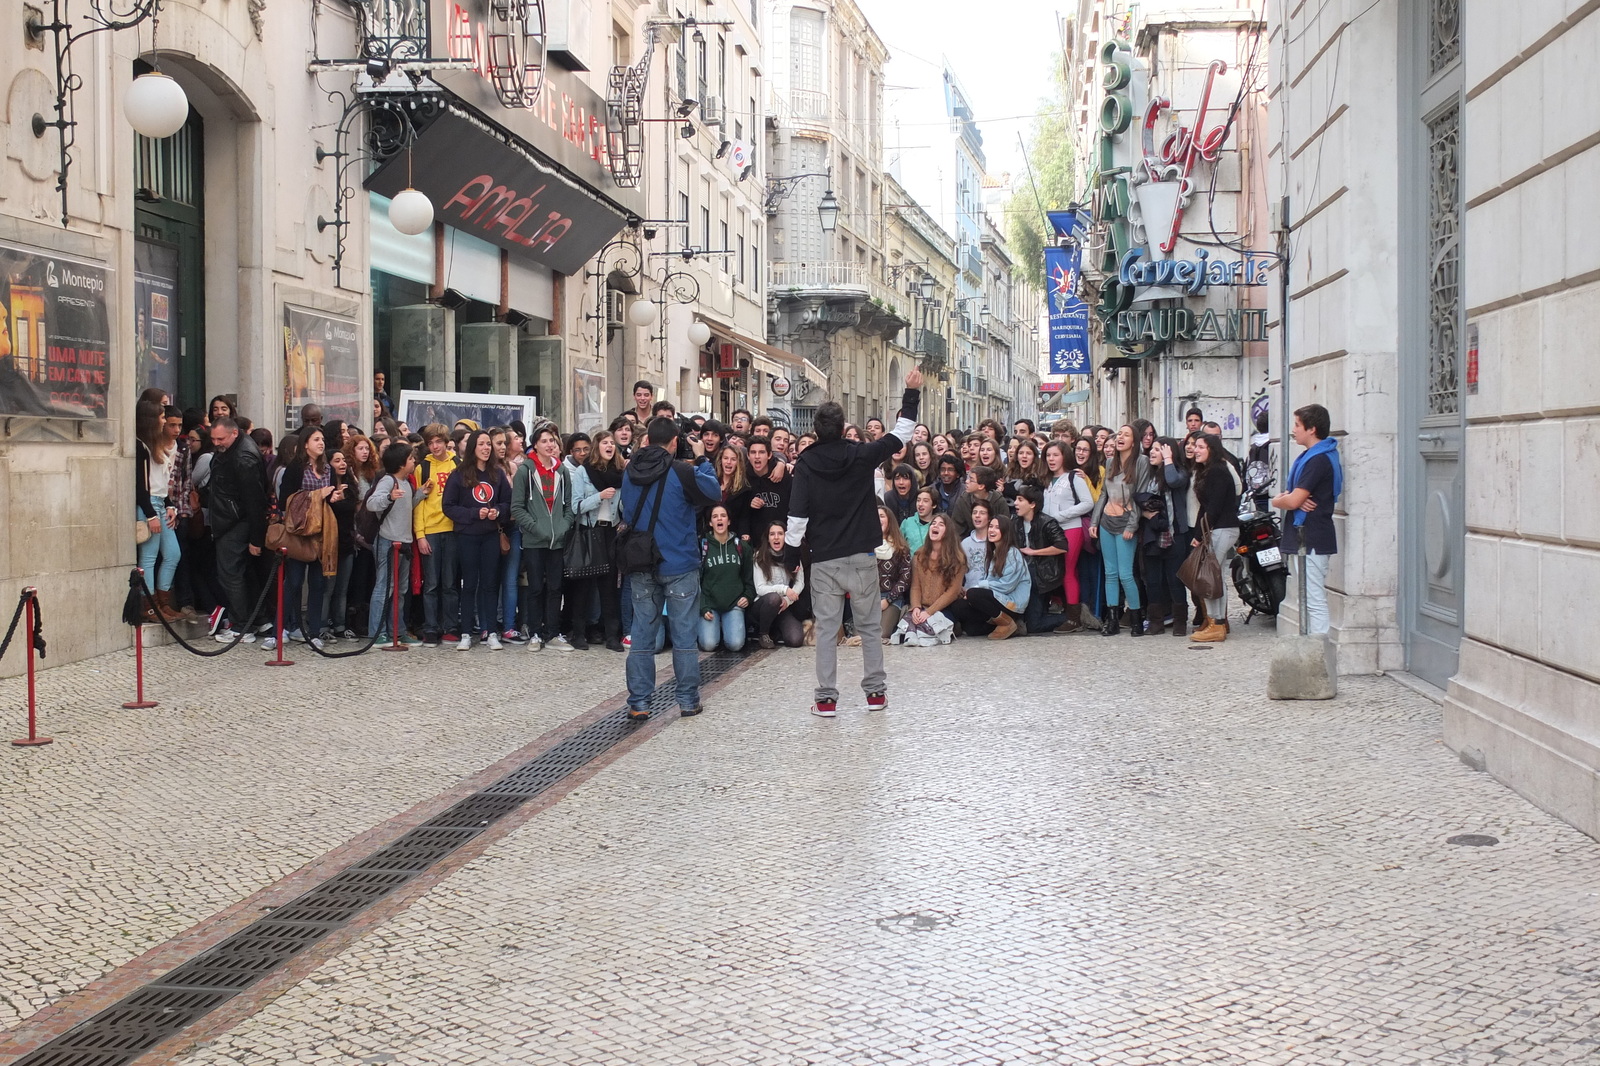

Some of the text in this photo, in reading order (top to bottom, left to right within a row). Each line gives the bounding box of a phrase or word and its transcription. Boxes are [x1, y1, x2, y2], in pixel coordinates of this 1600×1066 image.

[442, 174, 573, 254] AMÁLIA
[62, 269, 104, 293] Montepio
[57, 295, 95, 307] APRESENTA
[48, 346, 76, 363] UMA
[1063, 350, 1076, 360] 50
[1180, 360, 1194, 371] 104
[48, 366, 65, 381] EM
